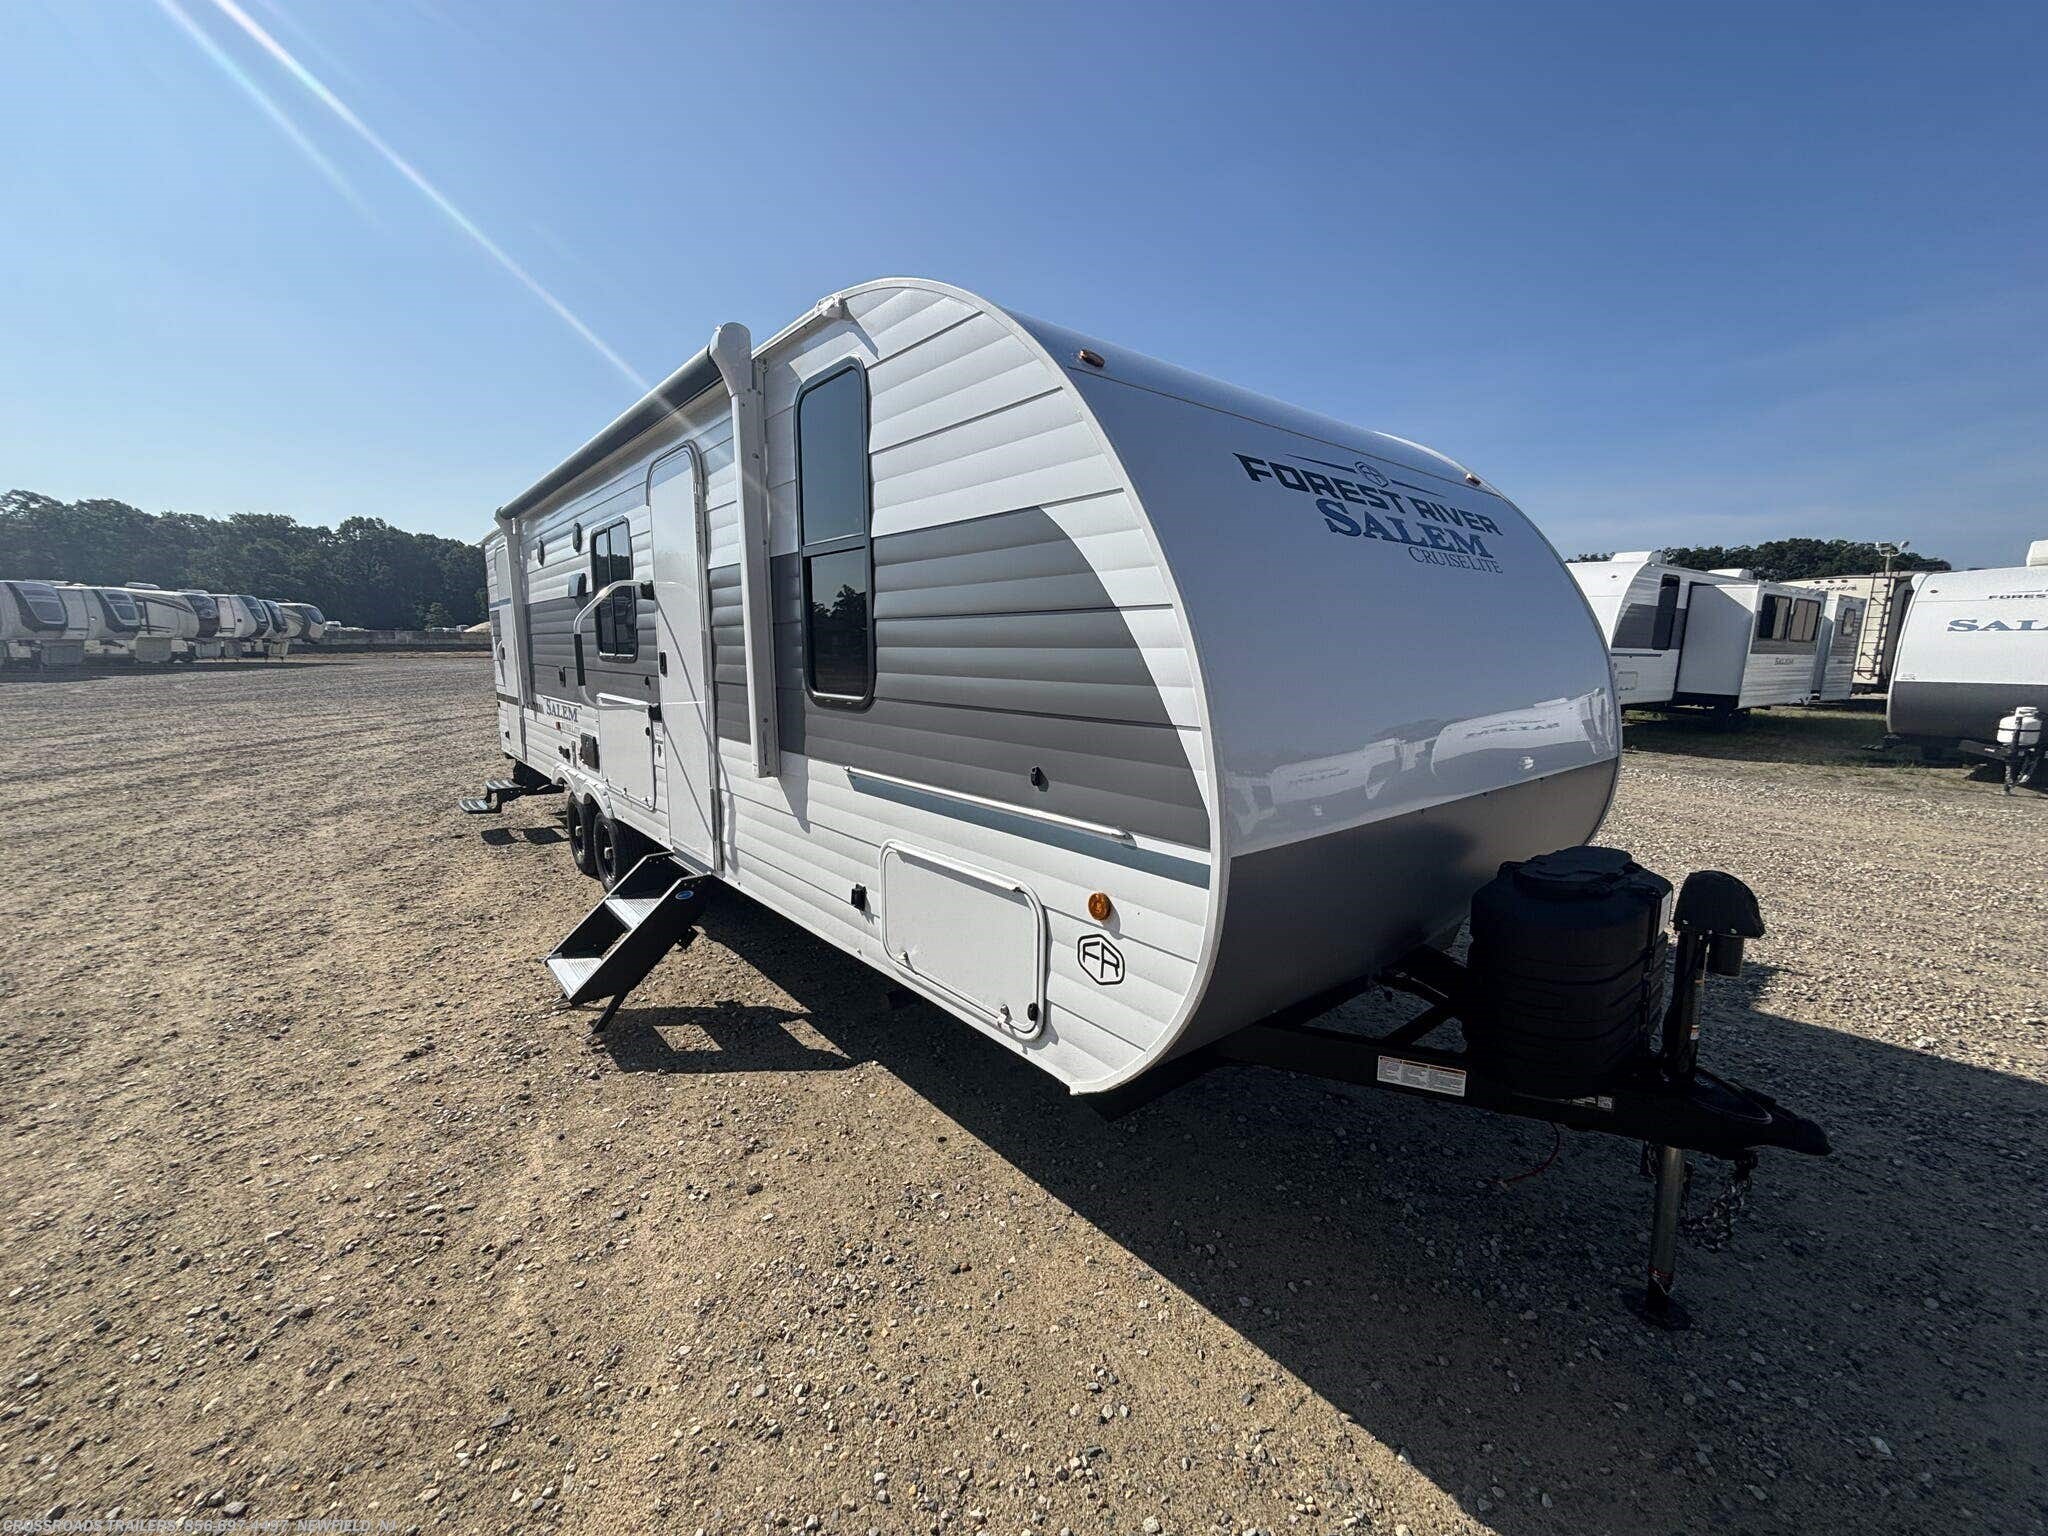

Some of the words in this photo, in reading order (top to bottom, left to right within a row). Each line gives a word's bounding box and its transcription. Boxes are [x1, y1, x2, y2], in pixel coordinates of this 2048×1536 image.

[1232, 452, 1406, 514] FOREST
[1406, 495, 1503, 536] RIVER
[1315, 498, 1494, 558] SALEM
[1408, 545, 1503, 574] CRUISELITE
[1946, 619, 2048, 631] SAL
[546, 699, 578, 722] SALEM
